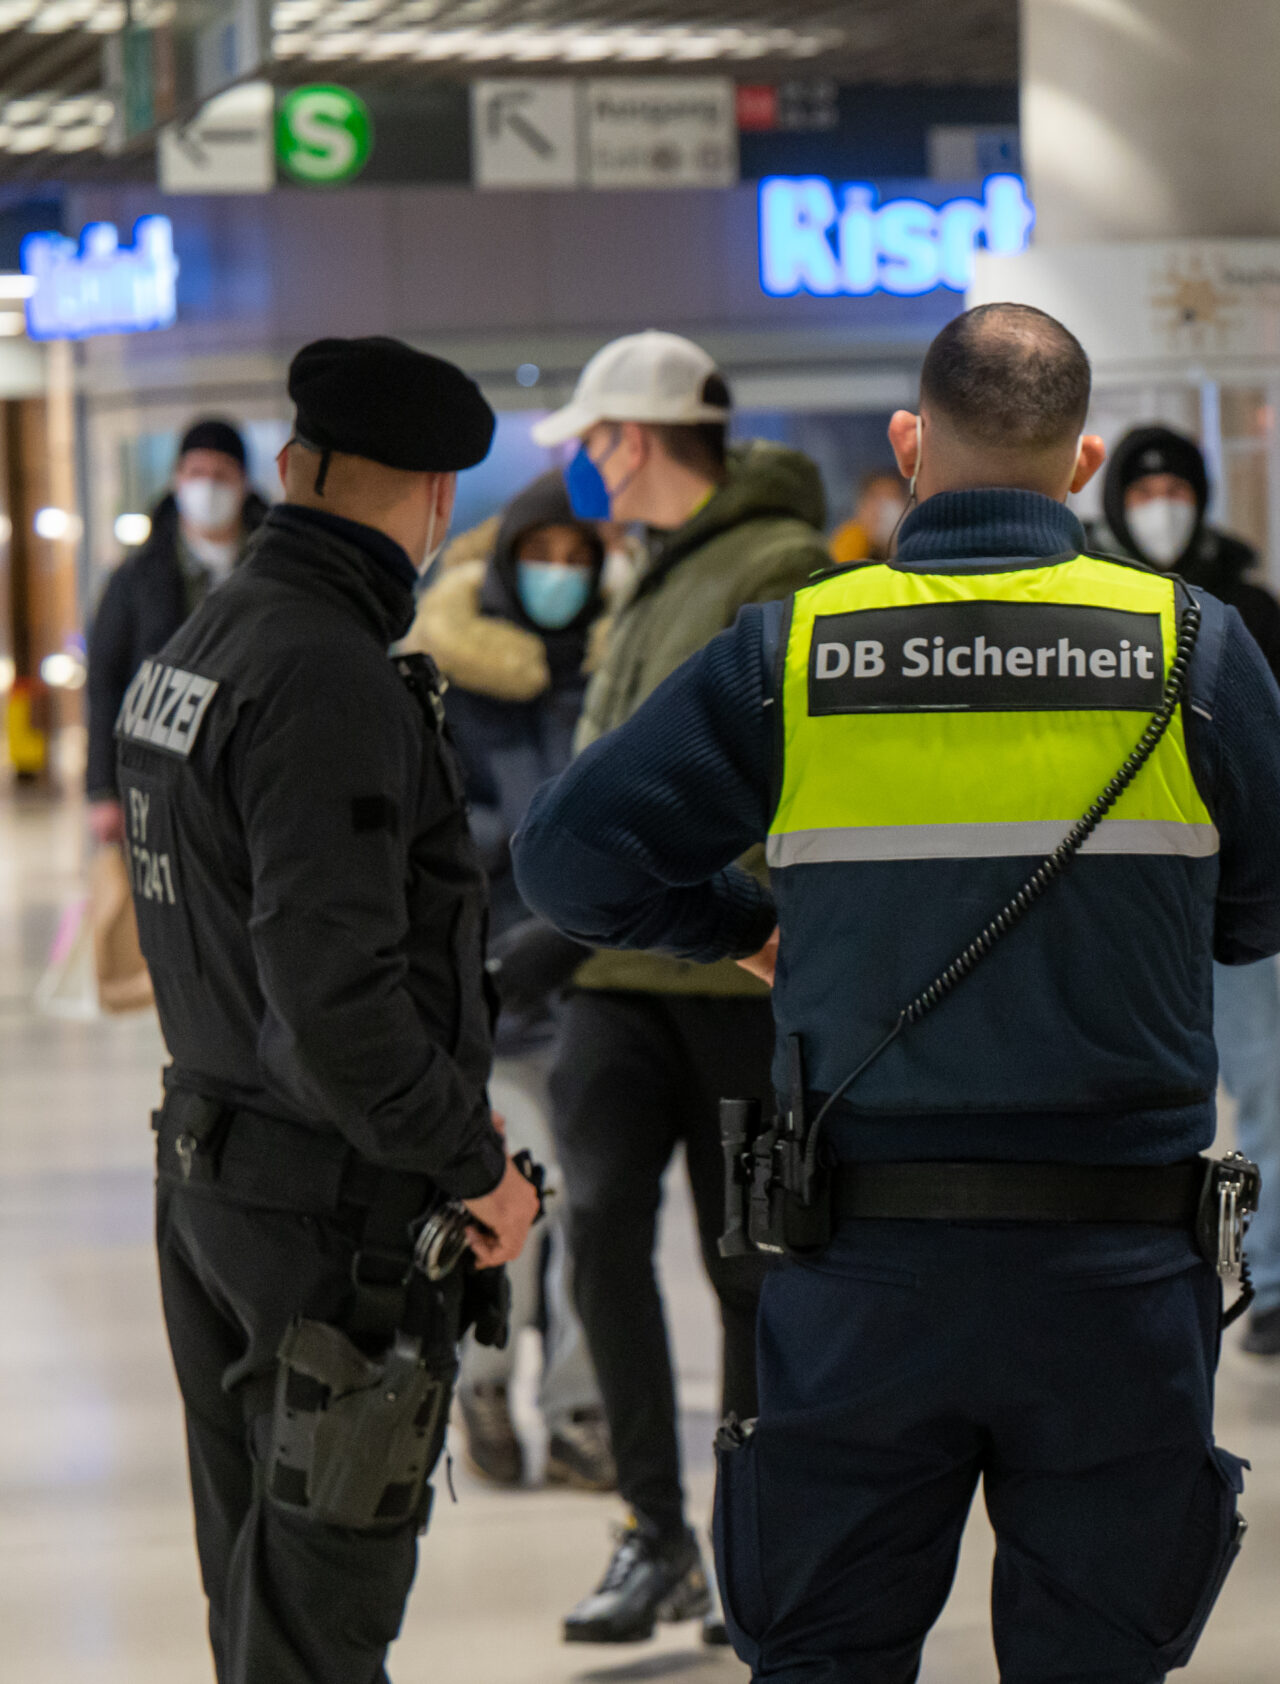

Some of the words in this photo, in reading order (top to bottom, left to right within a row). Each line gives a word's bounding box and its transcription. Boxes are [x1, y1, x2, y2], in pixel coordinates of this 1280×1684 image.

[287, 90, 358, 180] S
[815, 640, 886, 680] DB
[902, 635, 1155, 680] Sicherheit
[114, 660, 219, 755] OLIZEI
